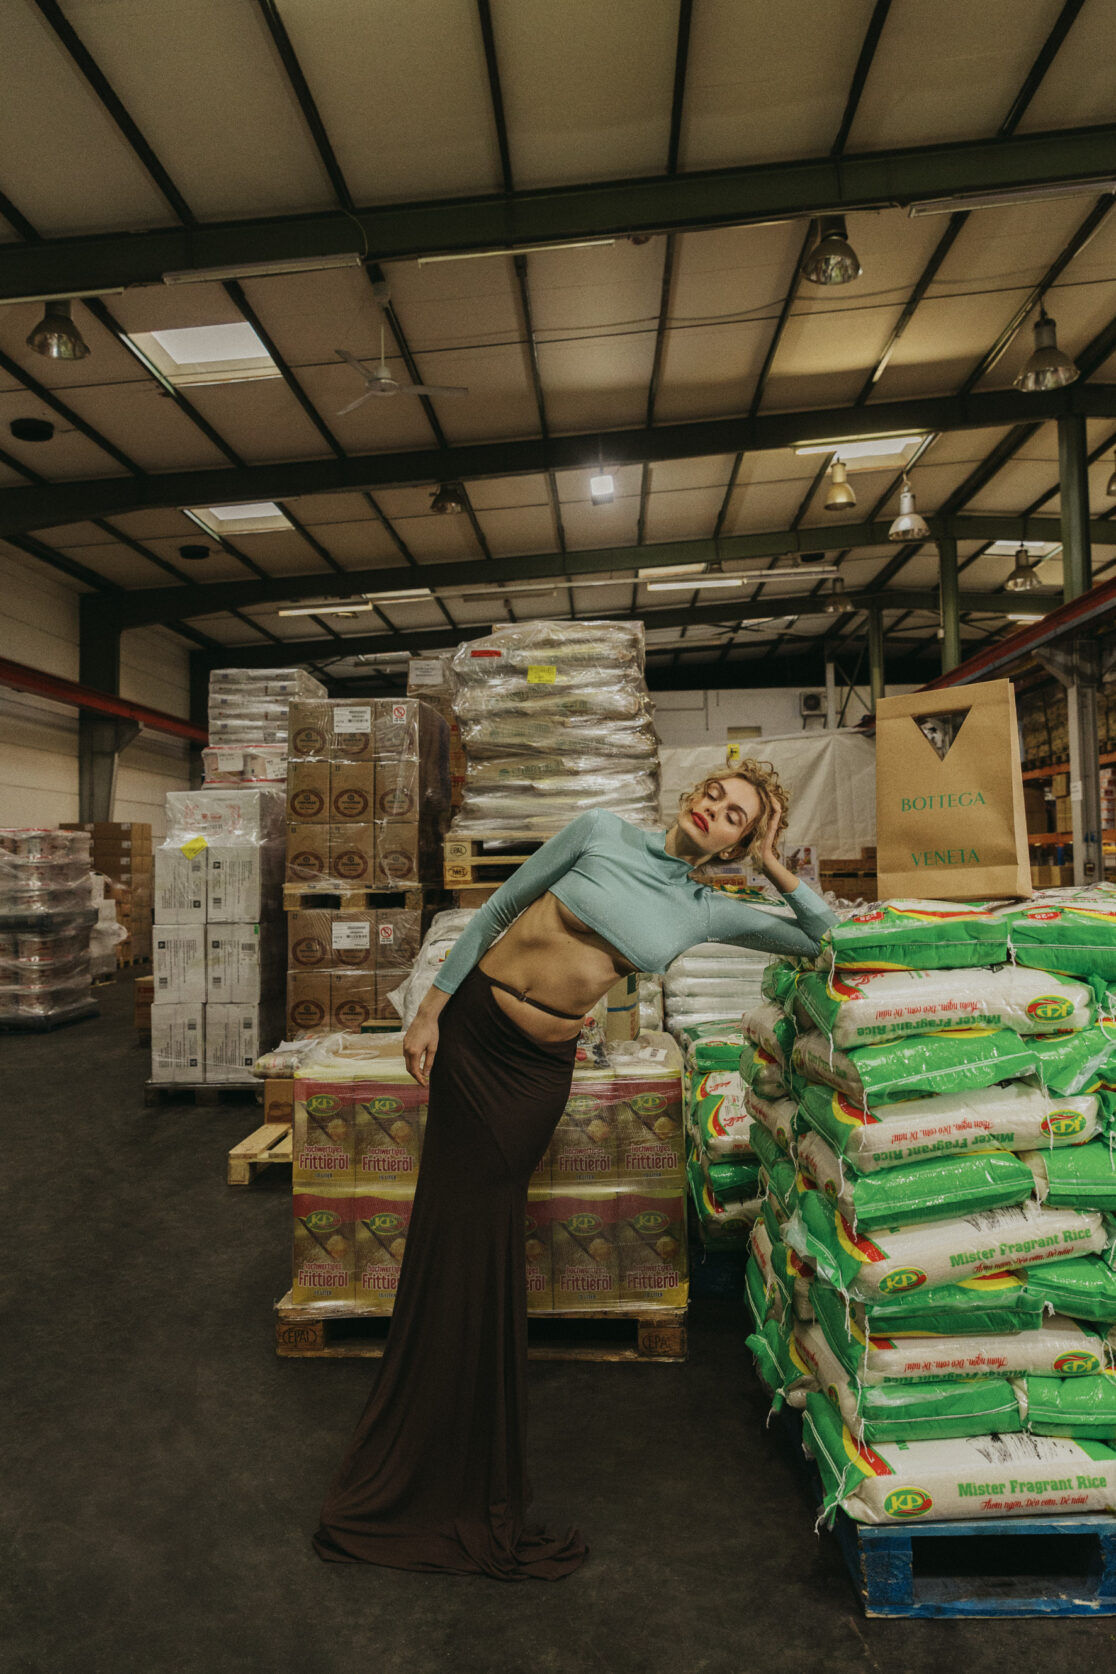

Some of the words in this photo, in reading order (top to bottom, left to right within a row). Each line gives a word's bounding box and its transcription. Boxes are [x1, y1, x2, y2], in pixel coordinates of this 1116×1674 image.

[901, 791, 986, 812] BOTTEGA
[911, 848, 980, 867] VENETA
[1036, 1001, 1072, 1018] KP
[856, 1021, 887, 1037] Rice
[890, 1018, 952, 1033] Fragrant
[373, 1100, 397, 1113] KP
[1050, 1116, 1082, 1132] KP
[872, 1147, 904, 1162] Rice
[907, 1137, 968, 1157] Fragrant
[299, 1153, 350, 1170] Frittieröl
[362, 1155, 413, 1172] Frittieröl
[559, 1155, 611, 1172] Frittieröl
[625, 1152, 677, 1170] Frittieröl
[309, 1214, 334, 1226] KP
[372, 1217, 397, 1229] KP
[572, 1217, 595, 1229] KP
[637, 1215, 662, 1226] KP
[949, 1247, 996, 1268] Mister
[999, 1235, 1060, 1255] Fragrant
[1062, 1228, 1092, 1243] Rice
[298, 1270, 349, 1287] Frittieröl
[560, 1275, 612, 1291] Frittieröl
[627, 1271, 679, 1290] Frittieröl
[885, 1273, 918, 1293] KP
[1061, 1357, 1096, 1374] KP
[957, 1481, 1006, 1498] Mister
[1009, 1477, 1073, 1495] Fragrant
[1076, 1475, 1107, 1490] Rice
[890, 1495, 924, 1513] KP
